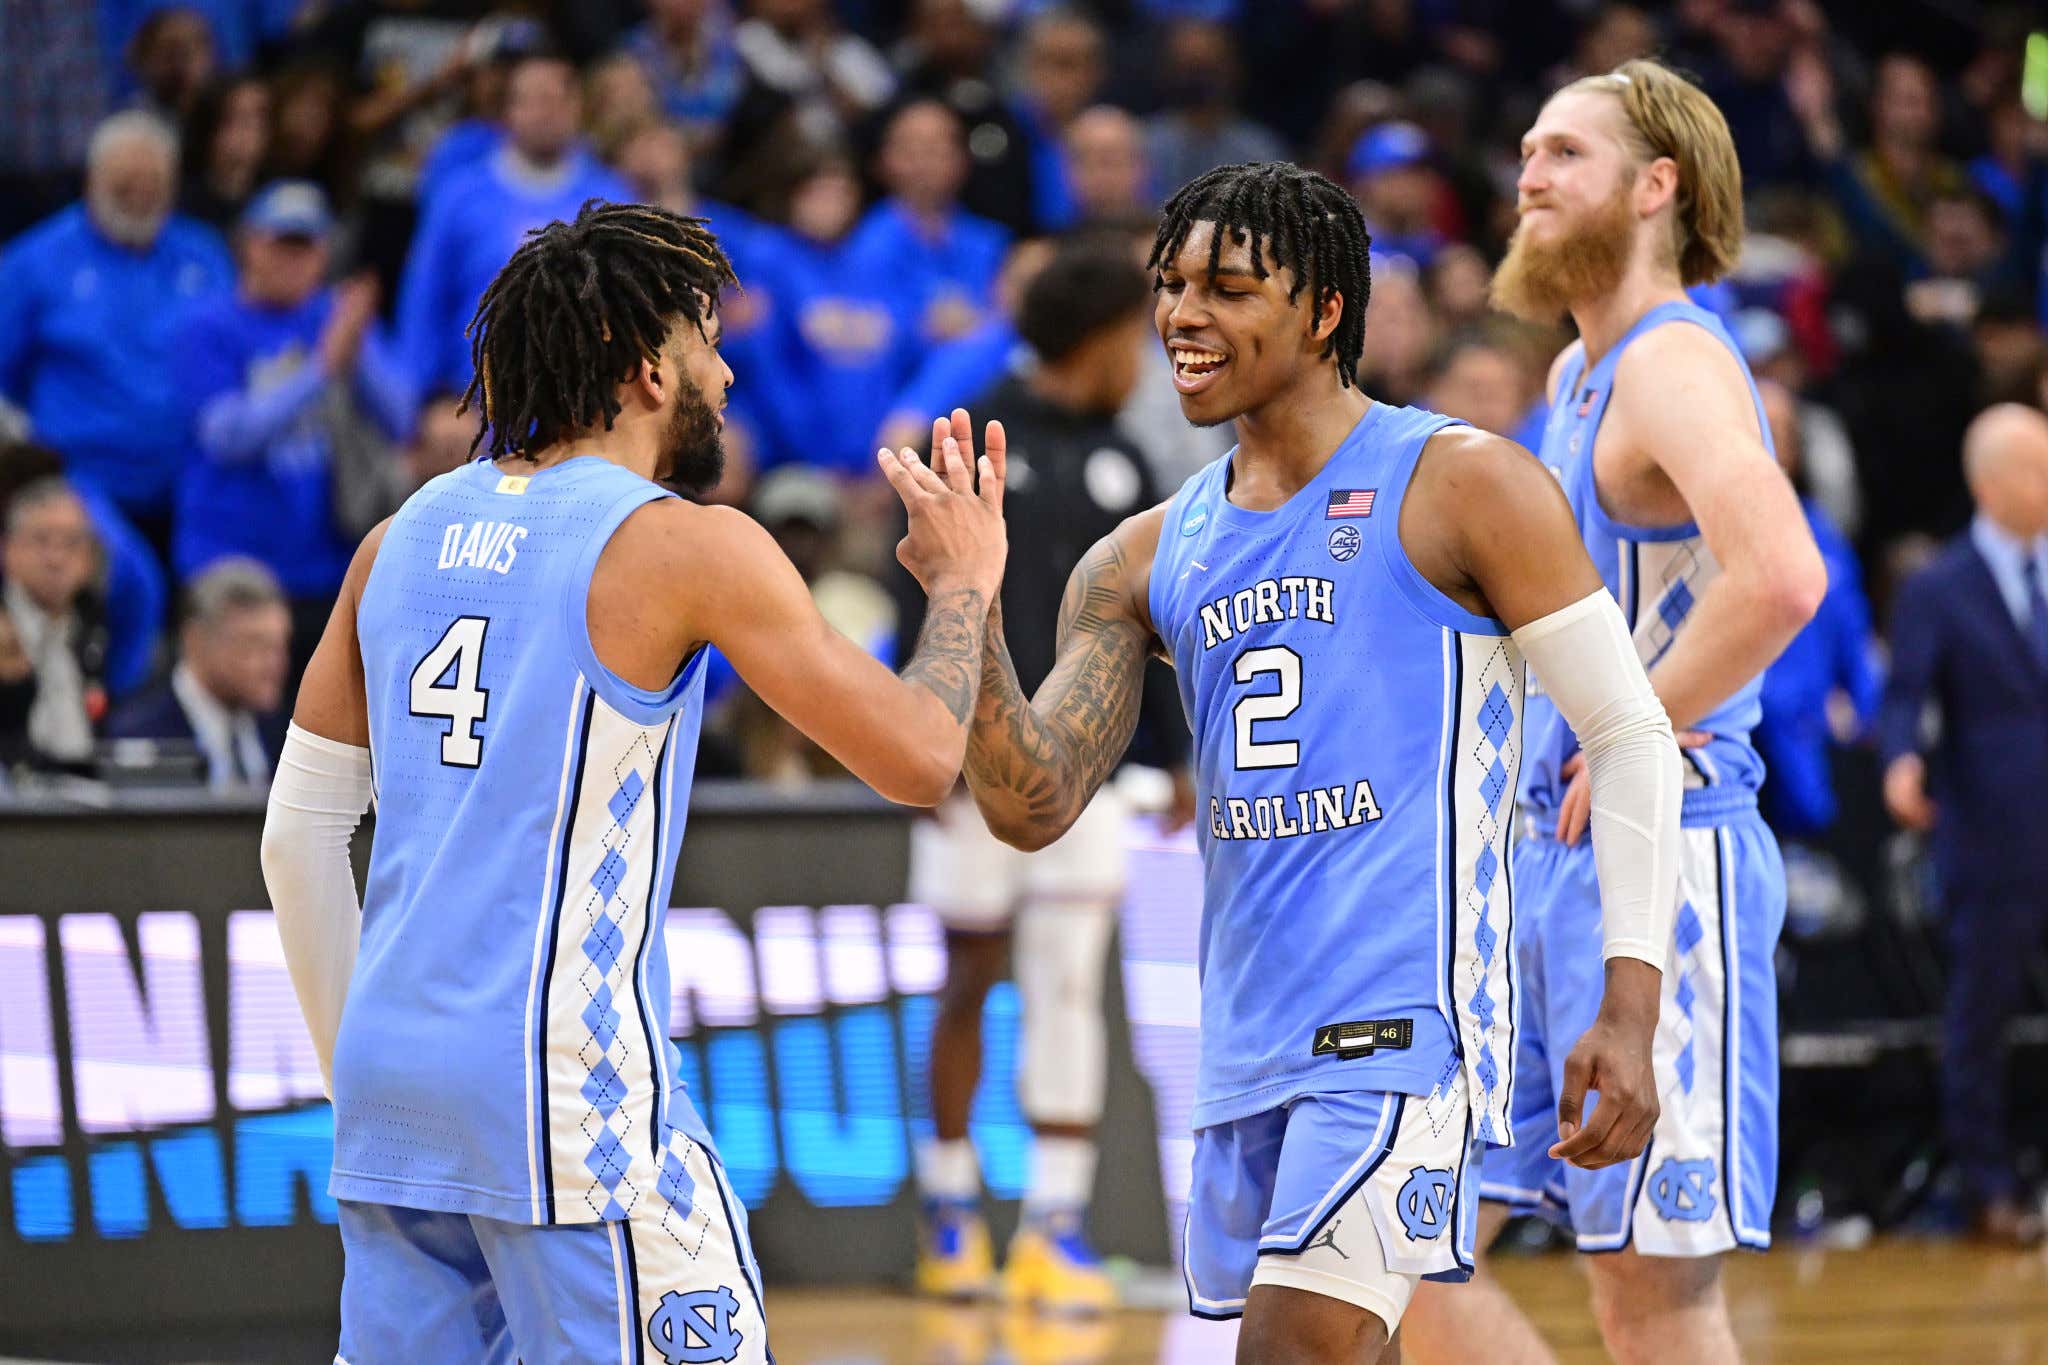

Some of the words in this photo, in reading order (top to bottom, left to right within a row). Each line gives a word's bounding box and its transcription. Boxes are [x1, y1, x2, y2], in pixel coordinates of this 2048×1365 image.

[438, 522, 528, 575] DAVIS
[1332, 535, 1360, 547] ACC
[1200, 575, 1335, 651] NORTH
[409, 615, 491, 768] 4
[1232, 644, 1303, 771] 2
[1380, 1027, 1398, 1039] 46
